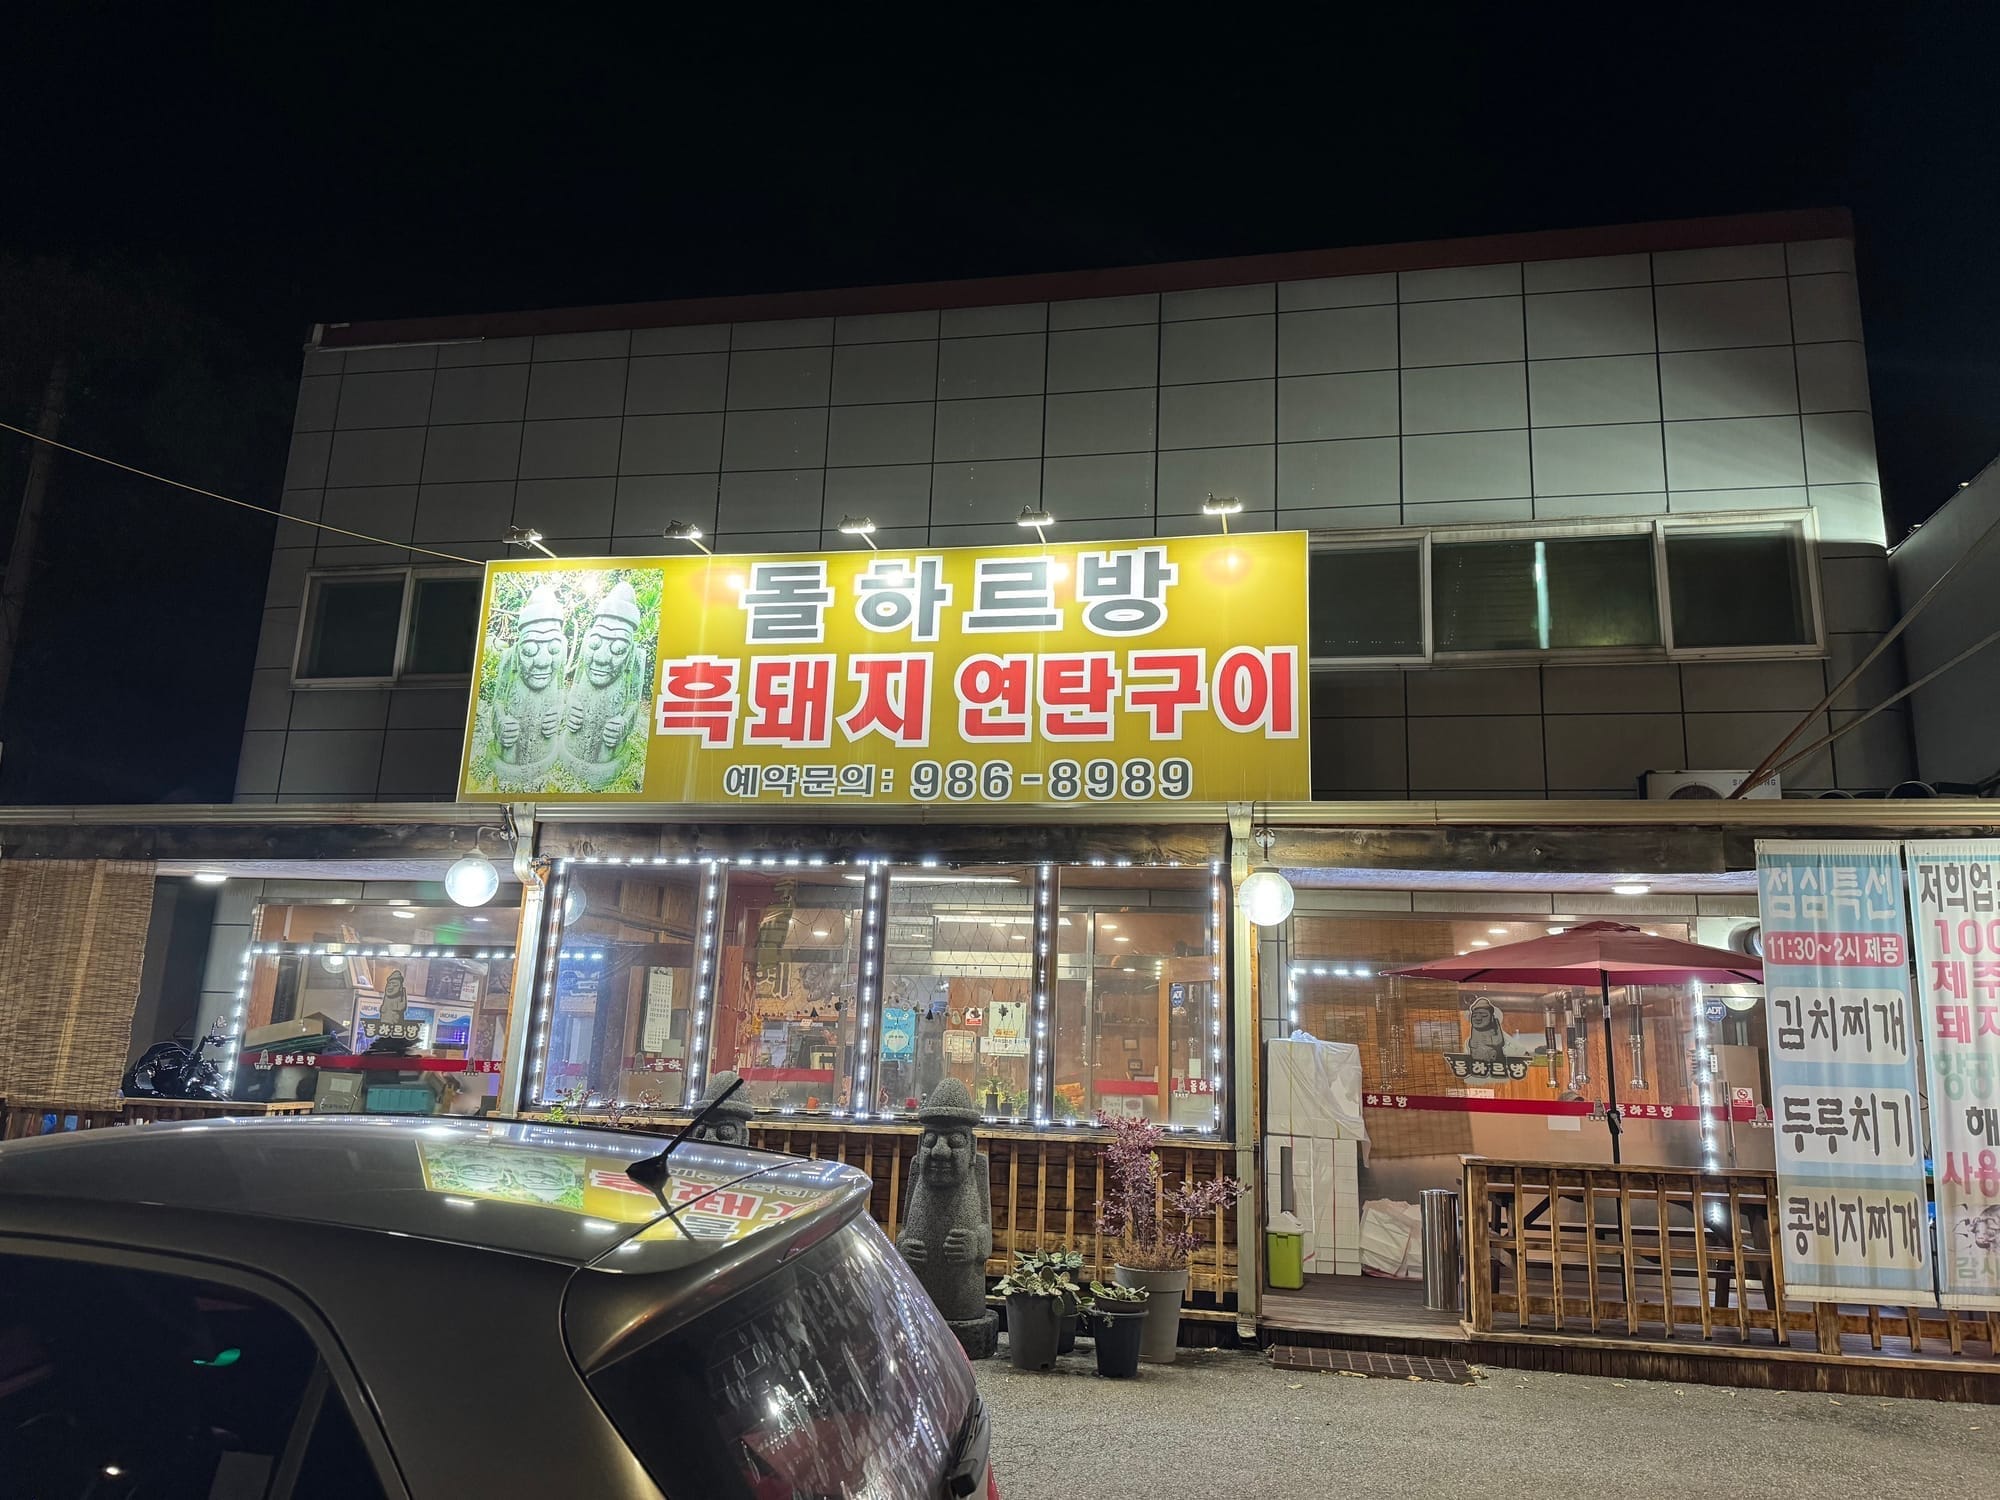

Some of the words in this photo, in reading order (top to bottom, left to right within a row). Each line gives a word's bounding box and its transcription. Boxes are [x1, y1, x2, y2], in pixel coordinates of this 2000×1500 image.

[742, 547, 1177, 643] 돌하르방
[656, 652, 932, 747] 흑돼지
[954, 646, 1303, 742] 연탄구이
[724, 764, 893, 797] 예약문의:
[910, 757, 1193, 800] 986-8989
[1766, 861, 1896, 921] 점심특선
[1706, 1006, 1722, 1015] ADT
[1775, 996, 1907, 1056] 김치찌개
[1454, 1060, 1526, 1078] 돌하르방
[1782, 1093, 1915, 1157] 두루치기
[1787, 1195, 1922, 1263] 콩비지찌개
